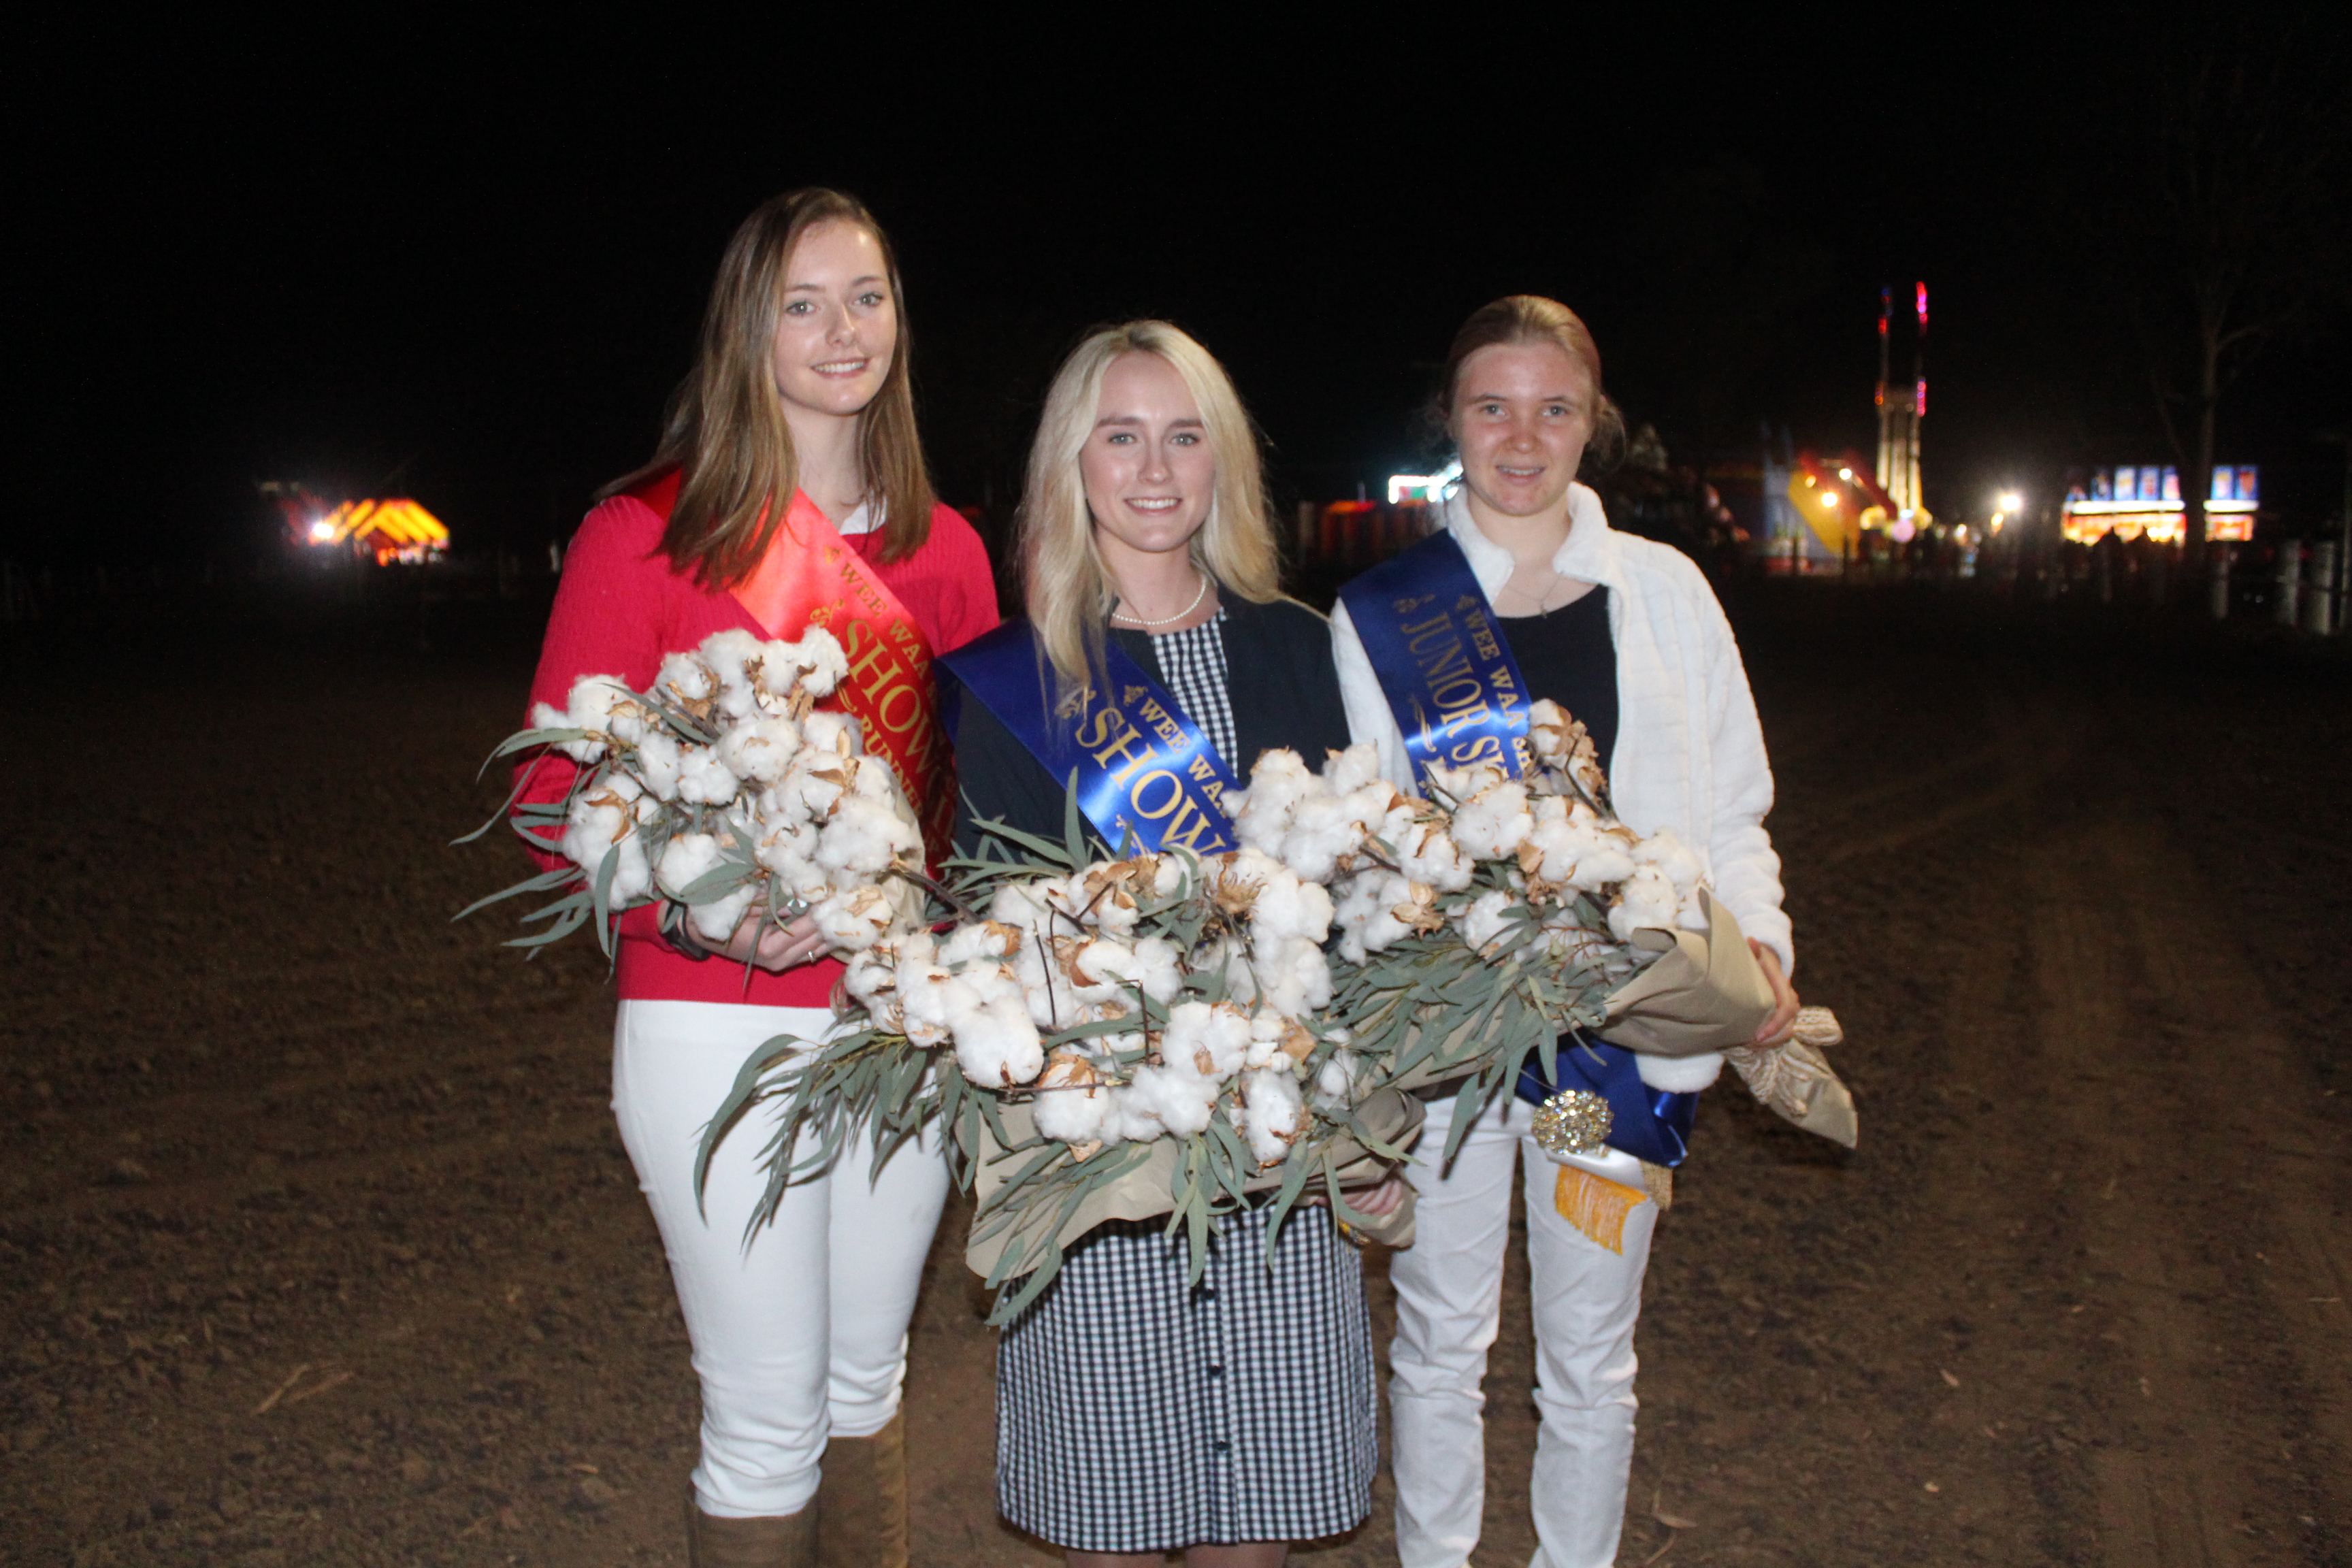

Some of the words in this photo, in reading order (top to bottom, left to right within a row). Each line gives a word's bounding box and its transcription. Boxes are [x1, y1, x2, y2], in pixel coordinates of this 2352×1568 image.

[839, 562, 889, 617] WEE
[889, 617, 929, 680] WAA
[1401, 611, 1491, 739] JUNIOR
[1464, 607, 1501, 662] WEE
[1489, 665, 1524, 729] WAA
[1138, 697, 1191, 754] WEE
[1188, 753, 1227, 819] WA
